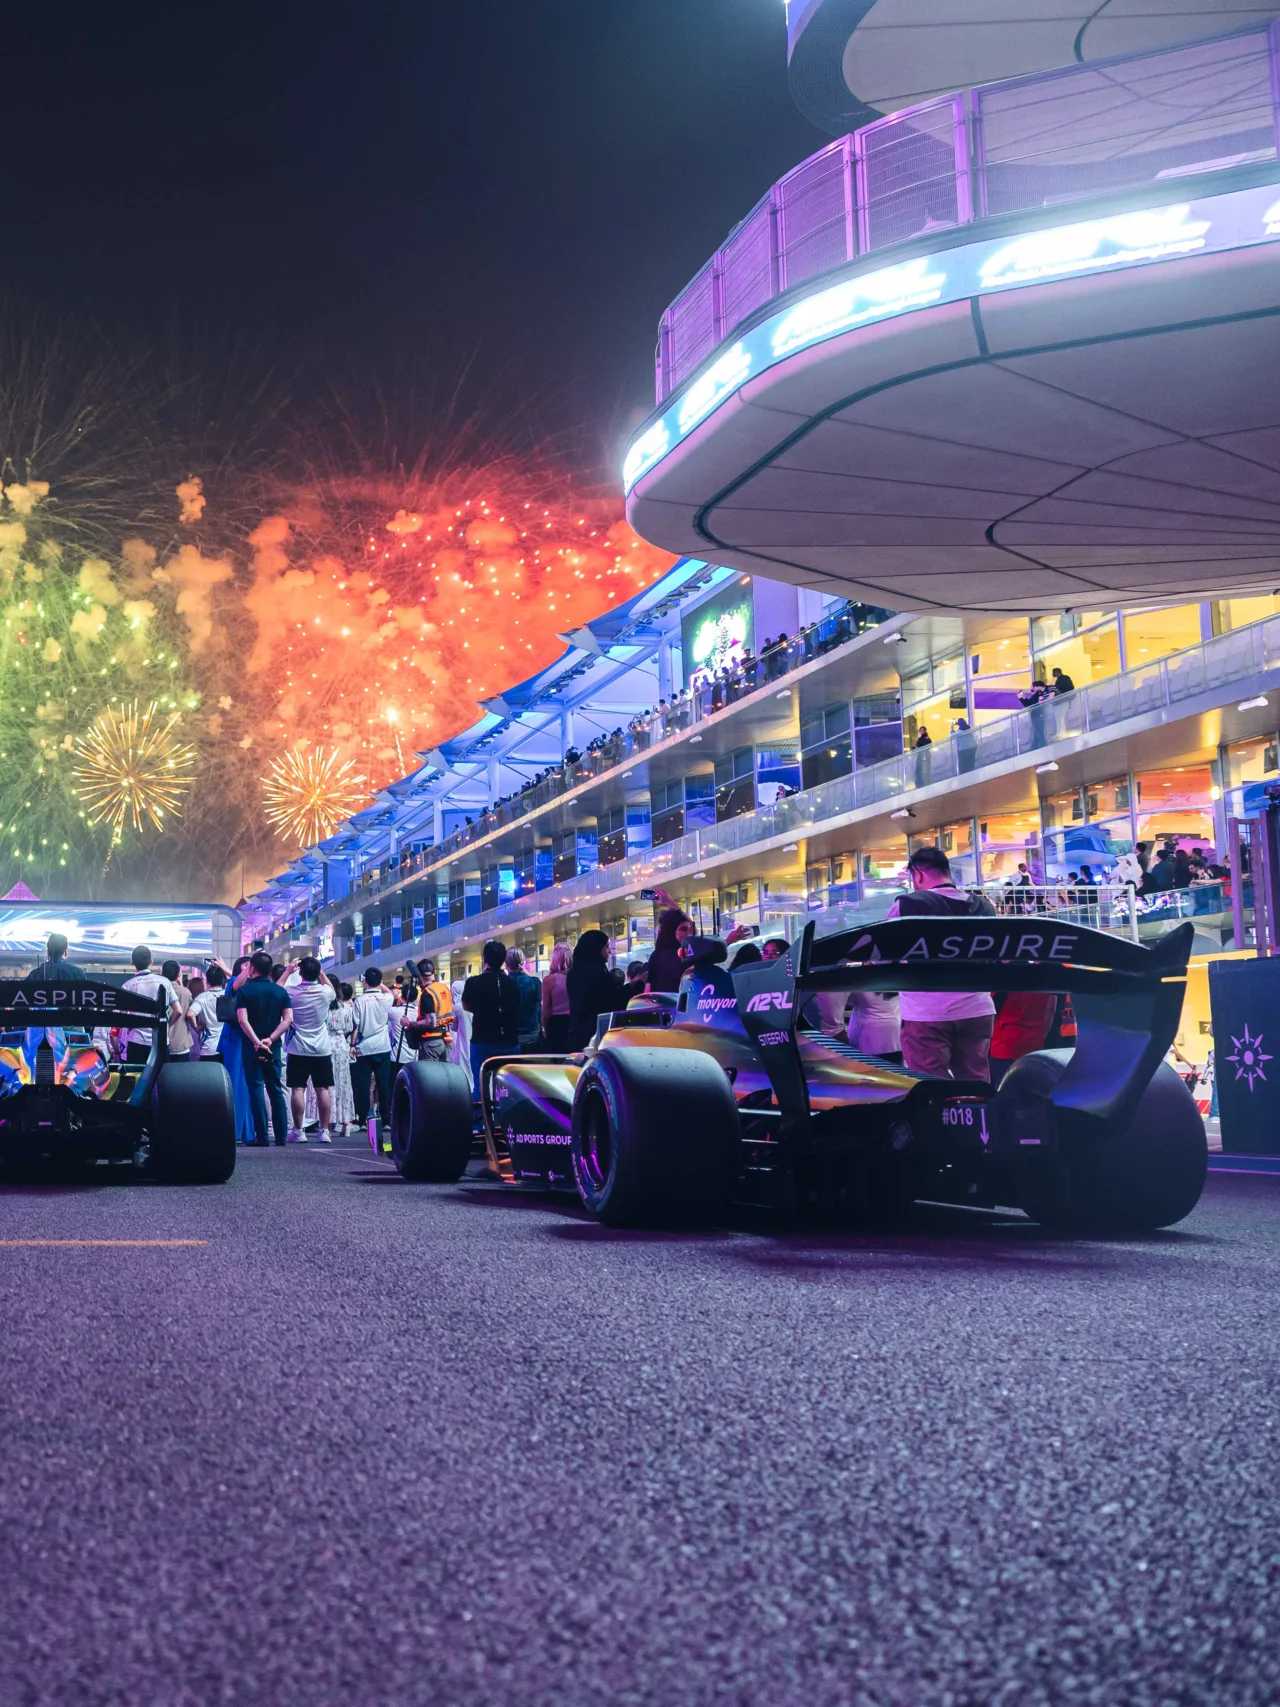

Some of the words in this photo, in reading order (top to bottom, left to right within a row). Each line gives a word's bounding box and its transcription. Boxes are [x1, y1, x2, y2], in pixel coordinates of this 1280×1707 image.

[901, 934, 1078, 960] ASPIRE
[11, 990, 117, 1007] ASPIRE
[696, 998, 737, 1012] movyon
[746, 991, 793, 1013] A2RL
[942, 1107, 973, 1126] #018
[516, 1134, 524, 1144] AD
[524, 1134, 544, 1144] PORTS
[545, 1135, 572, 1146] GROUP
